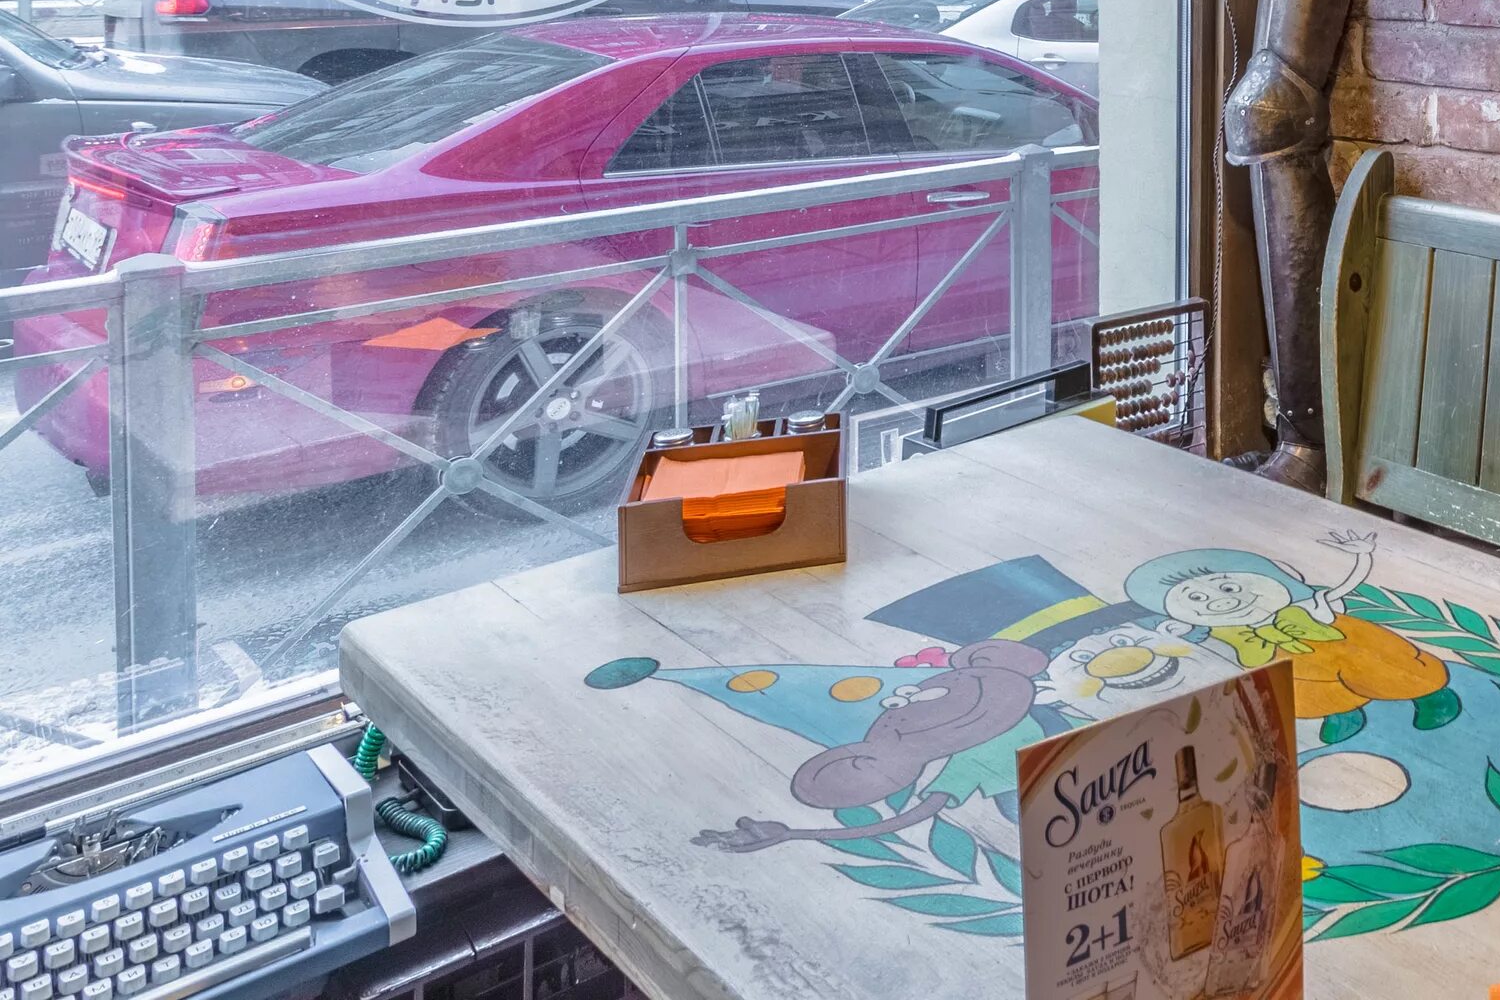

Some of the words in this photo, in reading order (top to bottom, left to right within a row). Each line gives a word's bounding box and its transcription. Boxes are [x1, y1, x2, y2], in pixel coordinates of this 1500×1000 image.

[1044, 740, 1157, 848] Sauza
[1067, 846, 1124, 876] вечеринку
[1068, 838, 1113, 863] Разбуди
[1076, 855, 1133, 889] ПЕРВОГО
[1066, 875, 1134, 912] ШОТА!
[1173, 877, 1209, 918] Sauza
[1217, 914, 1257, 951] Sauza
